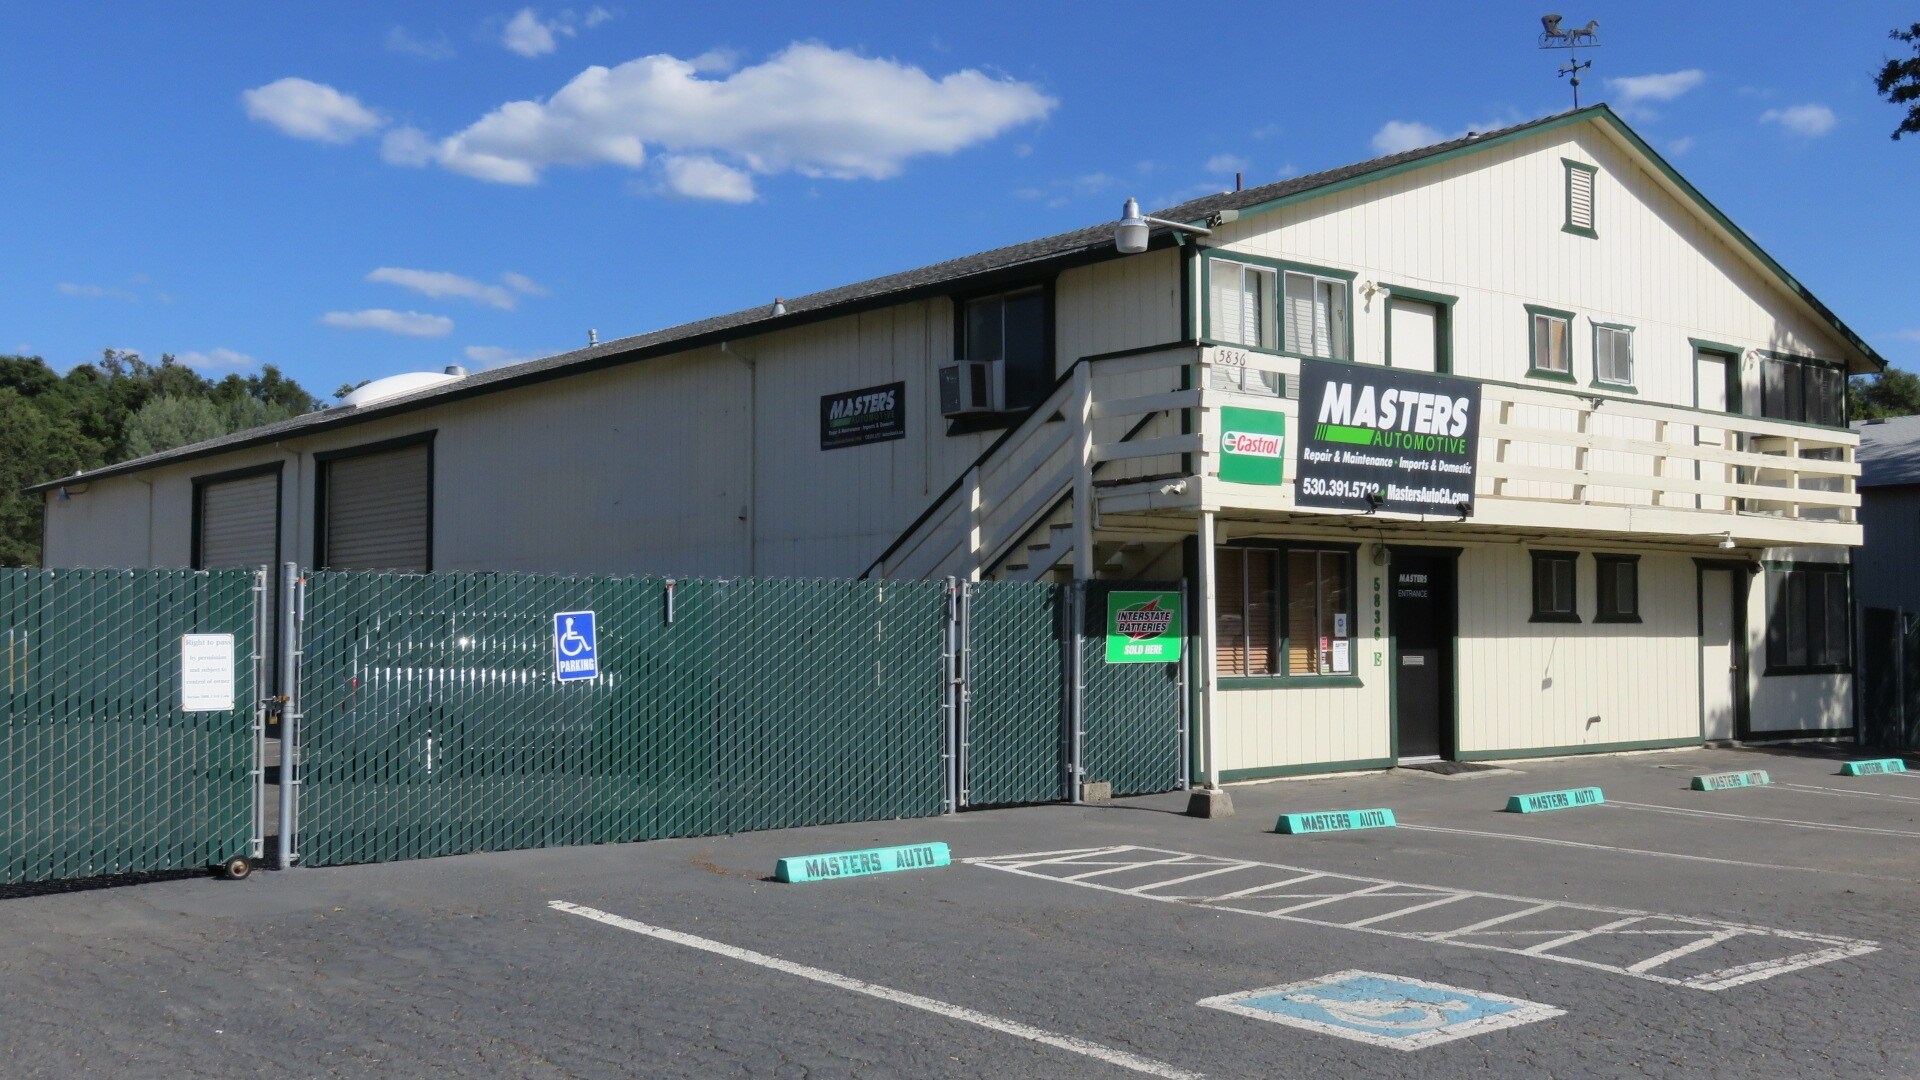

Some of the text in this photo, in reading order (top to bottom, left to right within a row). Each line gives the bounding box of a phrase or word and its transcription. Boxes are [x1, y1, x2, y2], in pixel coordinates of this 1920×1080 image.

[1219, 349, 1246, 366] 5836
[830, 390, 895, 420] MASTERS
[1317, 381, 1469, 437] MASTERS
[1237, 434, 1279, 455] Castrol
[1373, 430, 1467, 455] AUTOMOTIVE
[1303, 447, 1472, 474] Repair & Maintenance Imports & Domestic
[1387, 483, 1469, 505] MastersAutoCA.com
[1399, 573, 1428, 583] MASTERS
[1398, 589, 1428, 598] ENTRANCE
[1117, 611, 1171, 621] INTERSTATE
[1118, 623, 1167, 632] BATTERIES
[1124, 644, 1164, 655] SOLD HERE
[560, 658, 595, 673] PARKING
[1709, 772, 1763, 788] MASTERS AUTO
[1528, 790, 1596, 810] MASTERS AUTO
[1301, 811, 1385, 831] MASTERS AUTO
[805, 846, 935, 878] MASTERS AUTO
